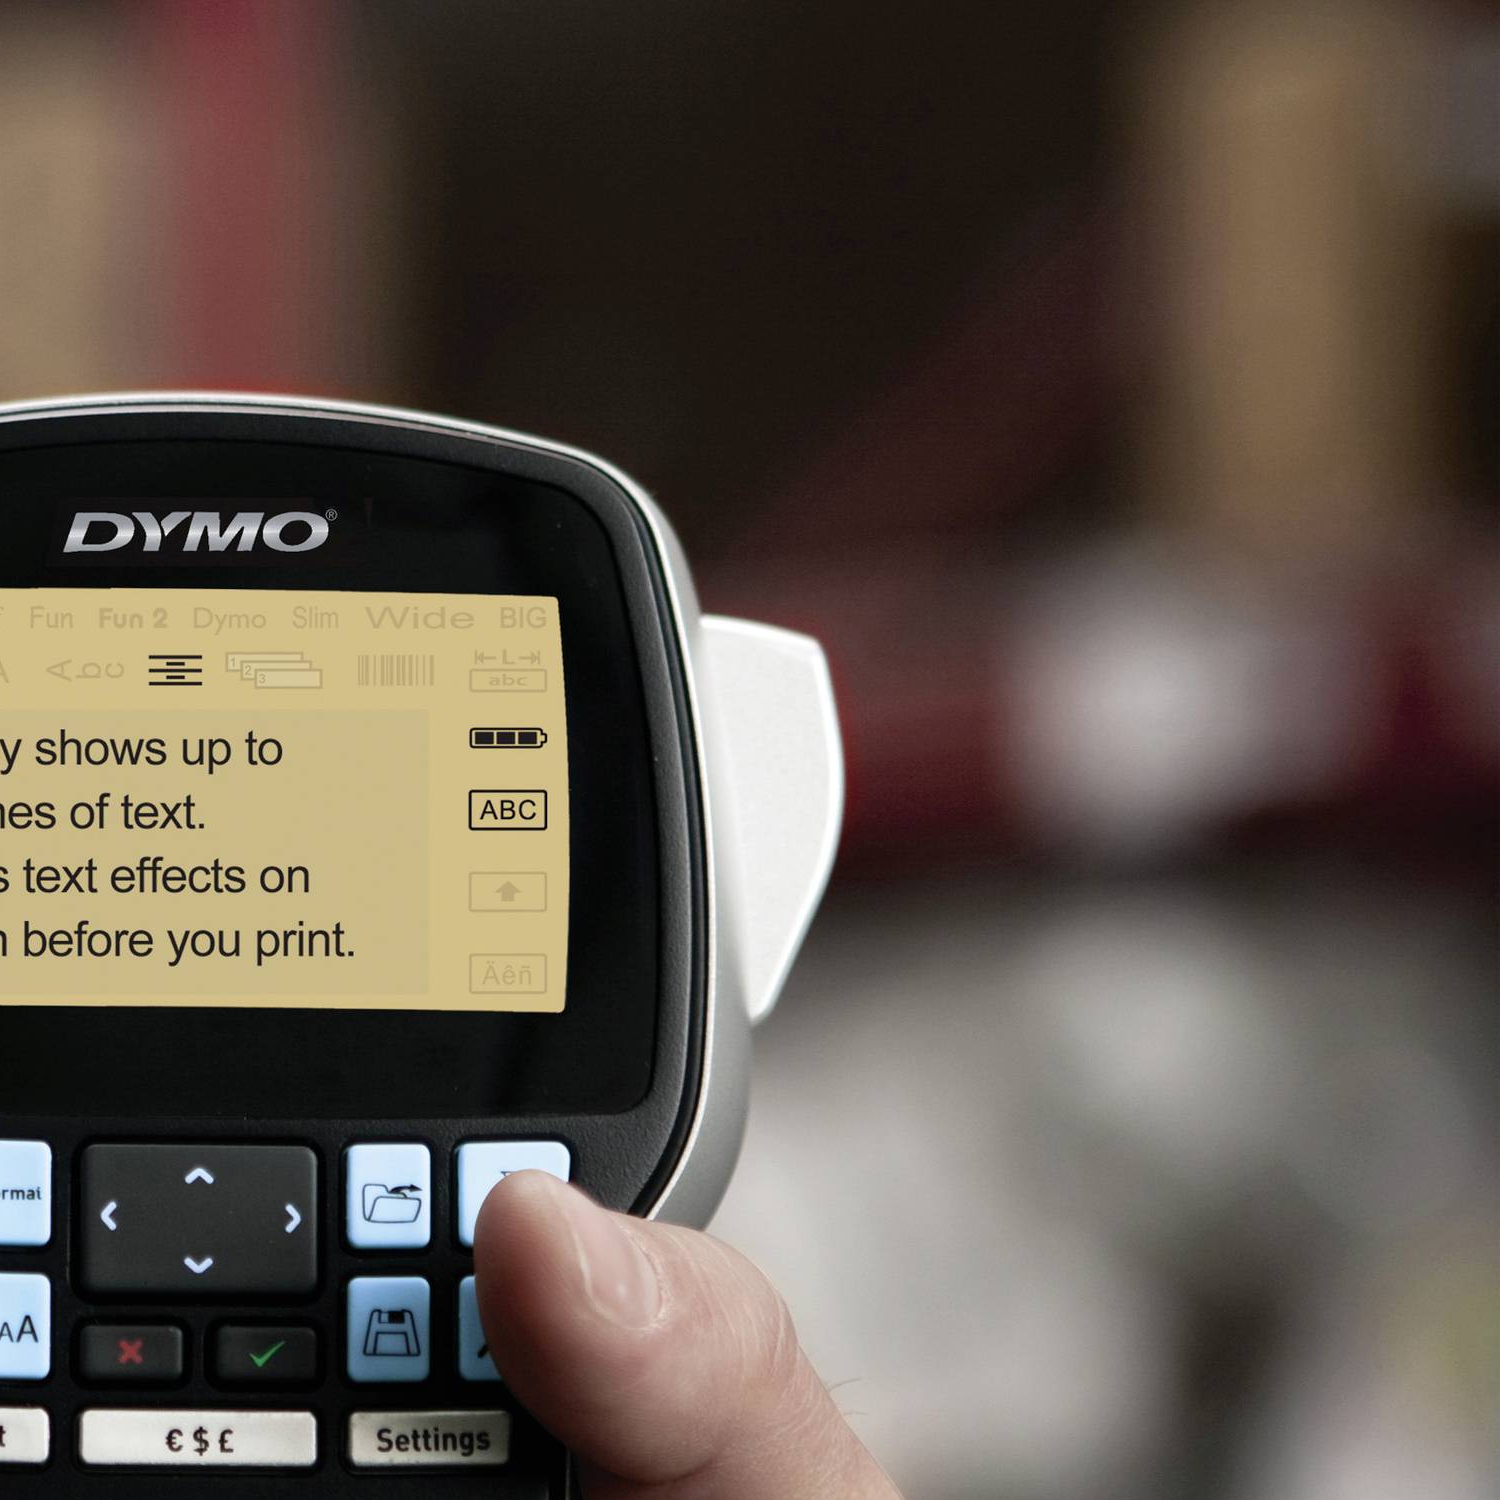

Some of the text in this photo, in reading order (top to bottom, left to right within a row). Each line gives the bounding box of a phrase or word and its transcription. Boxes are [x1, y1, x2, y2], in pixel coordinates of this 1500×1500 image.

[29, 605, 74, 630] Fun
[99, 607, 169, 630] Fun 2
[193, 606, 267, 636] Dymo
[292, 605, 339, 630] Slim
[364, 605, 475, 630] Wide
[499, 606, 548, 629] BIG
[243, 664, 253, 677] 2
[258, 672, 267, 685] 3
[488, 674, 529, 688] abc
[35, 728, 167, 766] shows
[182, 737, 232, 775] up
[244, 730, 283, 766] to
[69, 792, 111, 830] of
[121, 794, 205, 830] text.
[479, 799, 537, 821] ABC
[23, 857, 98, 894] text
[110, 856, 246, 894] effects
[259, 865, 310, 894] on
[23, 920, 154, 958] before
[167, 930, 241, 967] you
[256, 920, 355, 967] print.
[481, 961, 532, 986] Äêñ
[165, 1426, 234, 1456] € $ £
[376, 1427, 491, 1456] Settings
